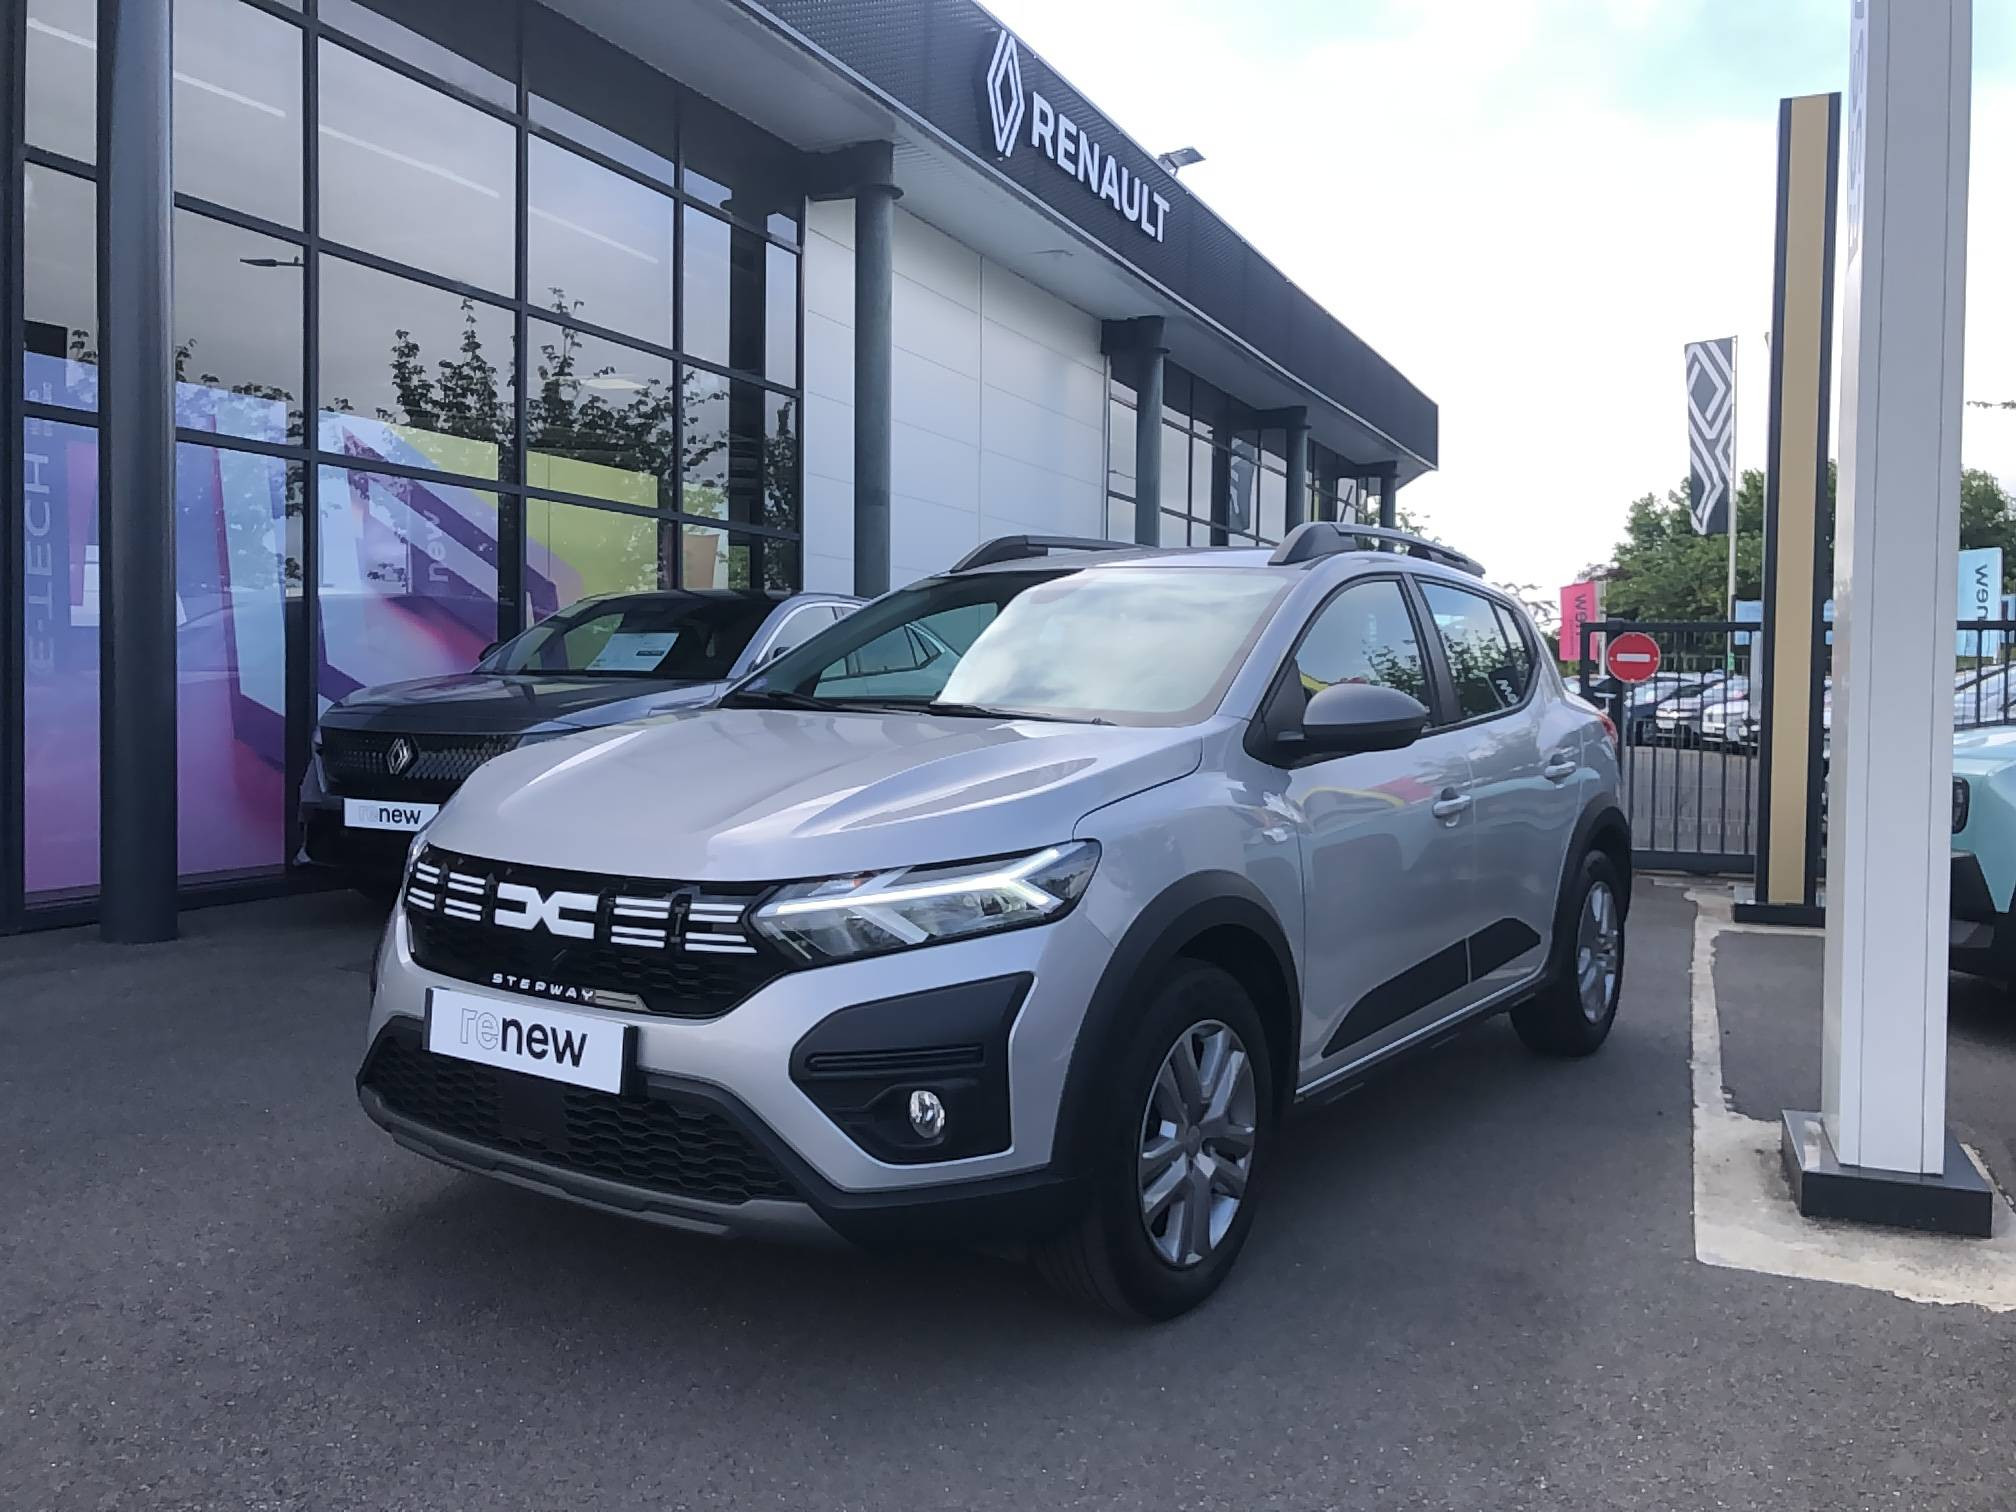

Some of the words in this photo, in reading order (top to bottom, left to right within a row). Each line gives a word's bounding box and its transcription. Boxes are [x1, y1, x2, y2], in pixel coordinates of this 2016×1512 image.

[1032, 91, 1170, 242] RENAULT
[491, 972, 595, 1001] STEPWAY
[460, 1007, 588, 1068] renew
